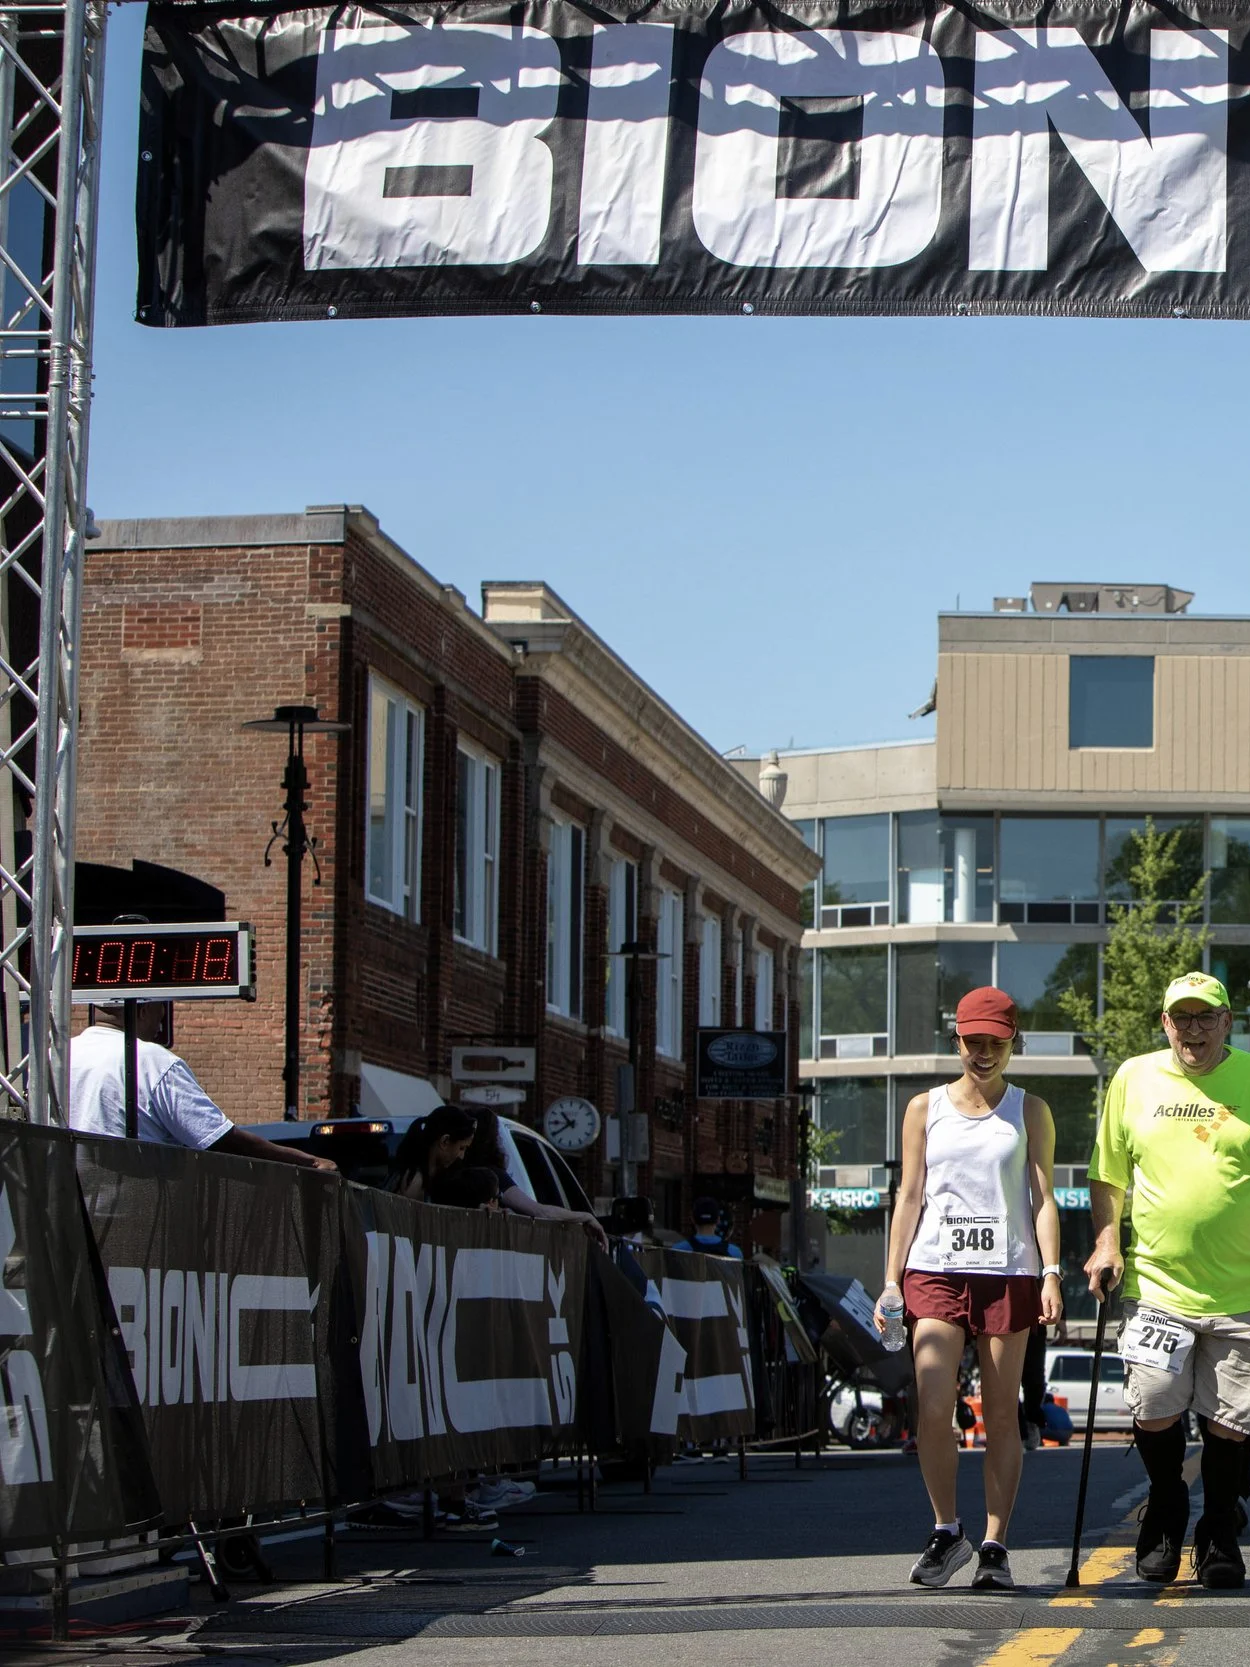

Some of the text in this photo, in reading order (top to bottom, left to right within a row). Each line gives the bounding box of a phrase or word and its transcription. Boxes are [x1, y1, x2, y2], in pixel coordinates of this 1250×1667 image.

[1153, 1103, 1216, 1118] Achilles
[810, 1189, 875, 1208] KENSHO
[1053, 1190, 1090, 1208] NSH
[946, 1215, 991, 1225] BIONIC
[951, 1227, 994, 1252] 348
[1140, 1313, 1182, 1330] BIONIC
[108, 1266, 317, 1407] BIONIC
[1138, 1325, 1180, 1354] 275
